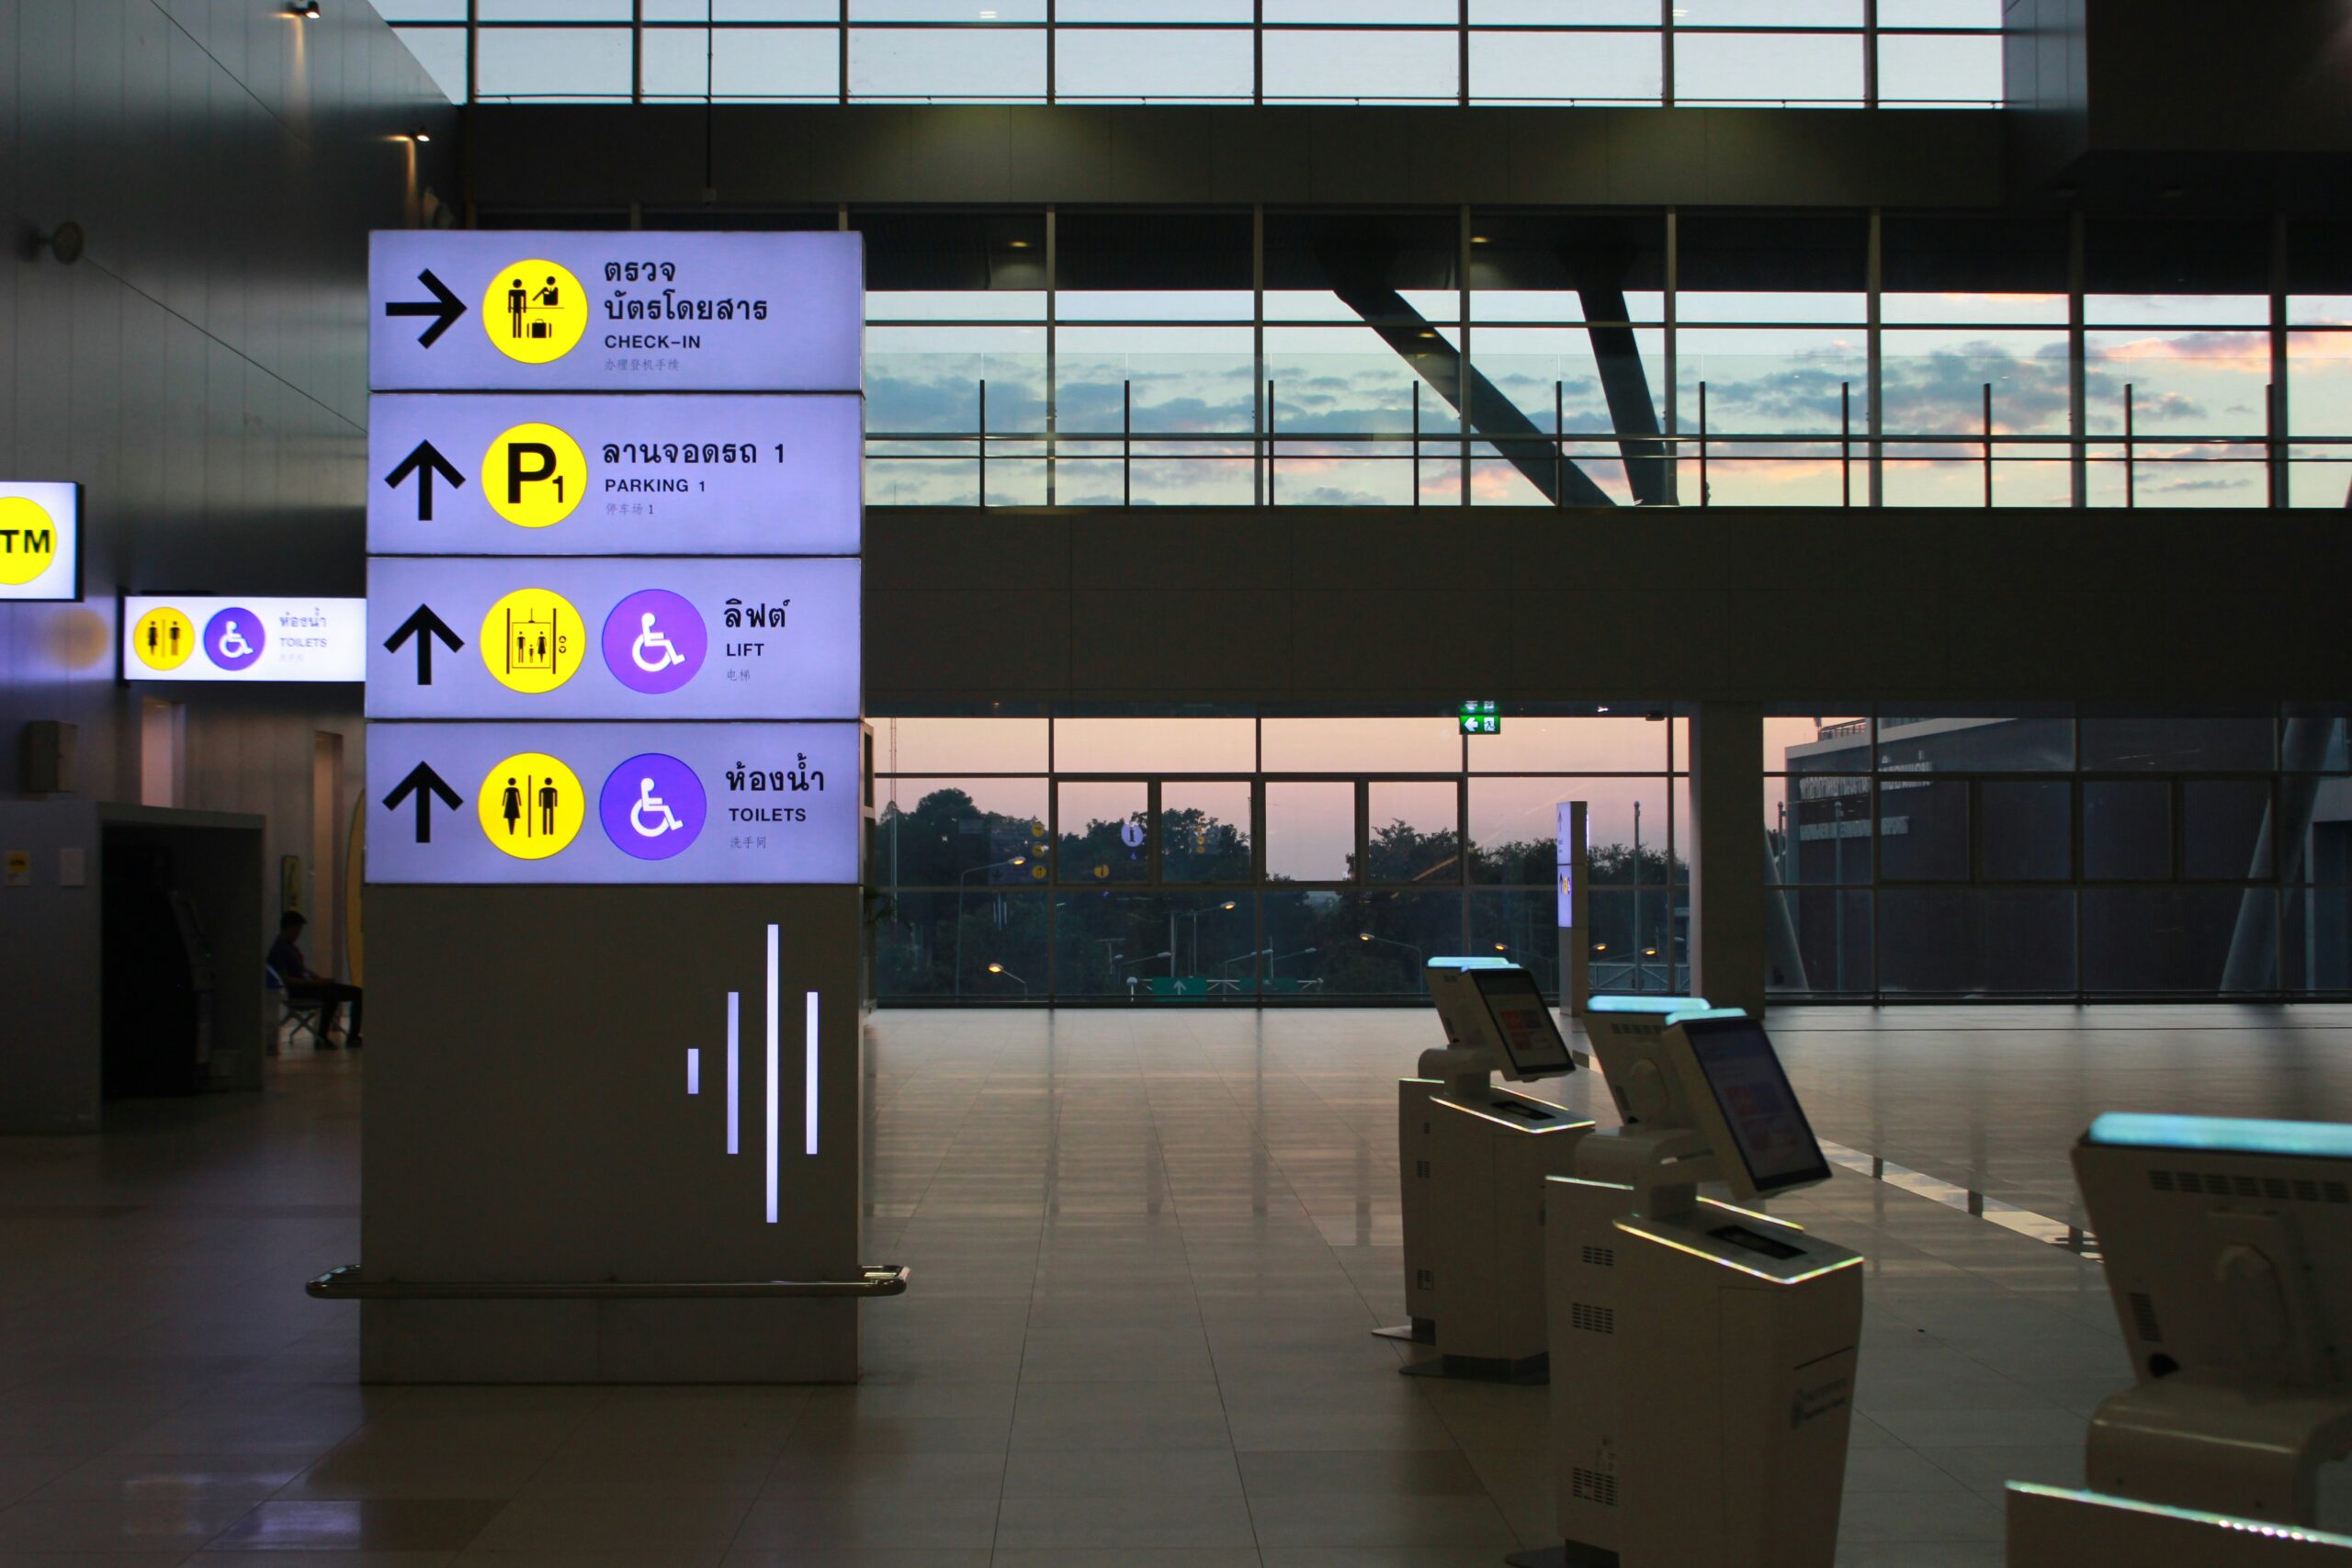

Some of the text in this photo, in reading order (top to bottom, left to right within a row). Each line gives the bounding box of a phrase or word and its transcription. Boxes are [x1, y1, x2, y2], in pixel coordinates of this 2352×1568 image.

[605, 262, 676, 282] ตรวจ
[605, 288, 768, 320] บัตรโดยสาร
[603, 443, 784, 464] ลานจอดรถ 1
[605, 479, 706, 492] PARKING 1
[0, 529, 51, 553] TM
[724, 598, 791, 627] ลิฟต์
[279, 637, 327, 648] TOILETS
[727, 643, 764, 657] LIFT
[726, 752, 824, 791] ห้องน้ำ
[729, 807, 807, 822] TOILETS
